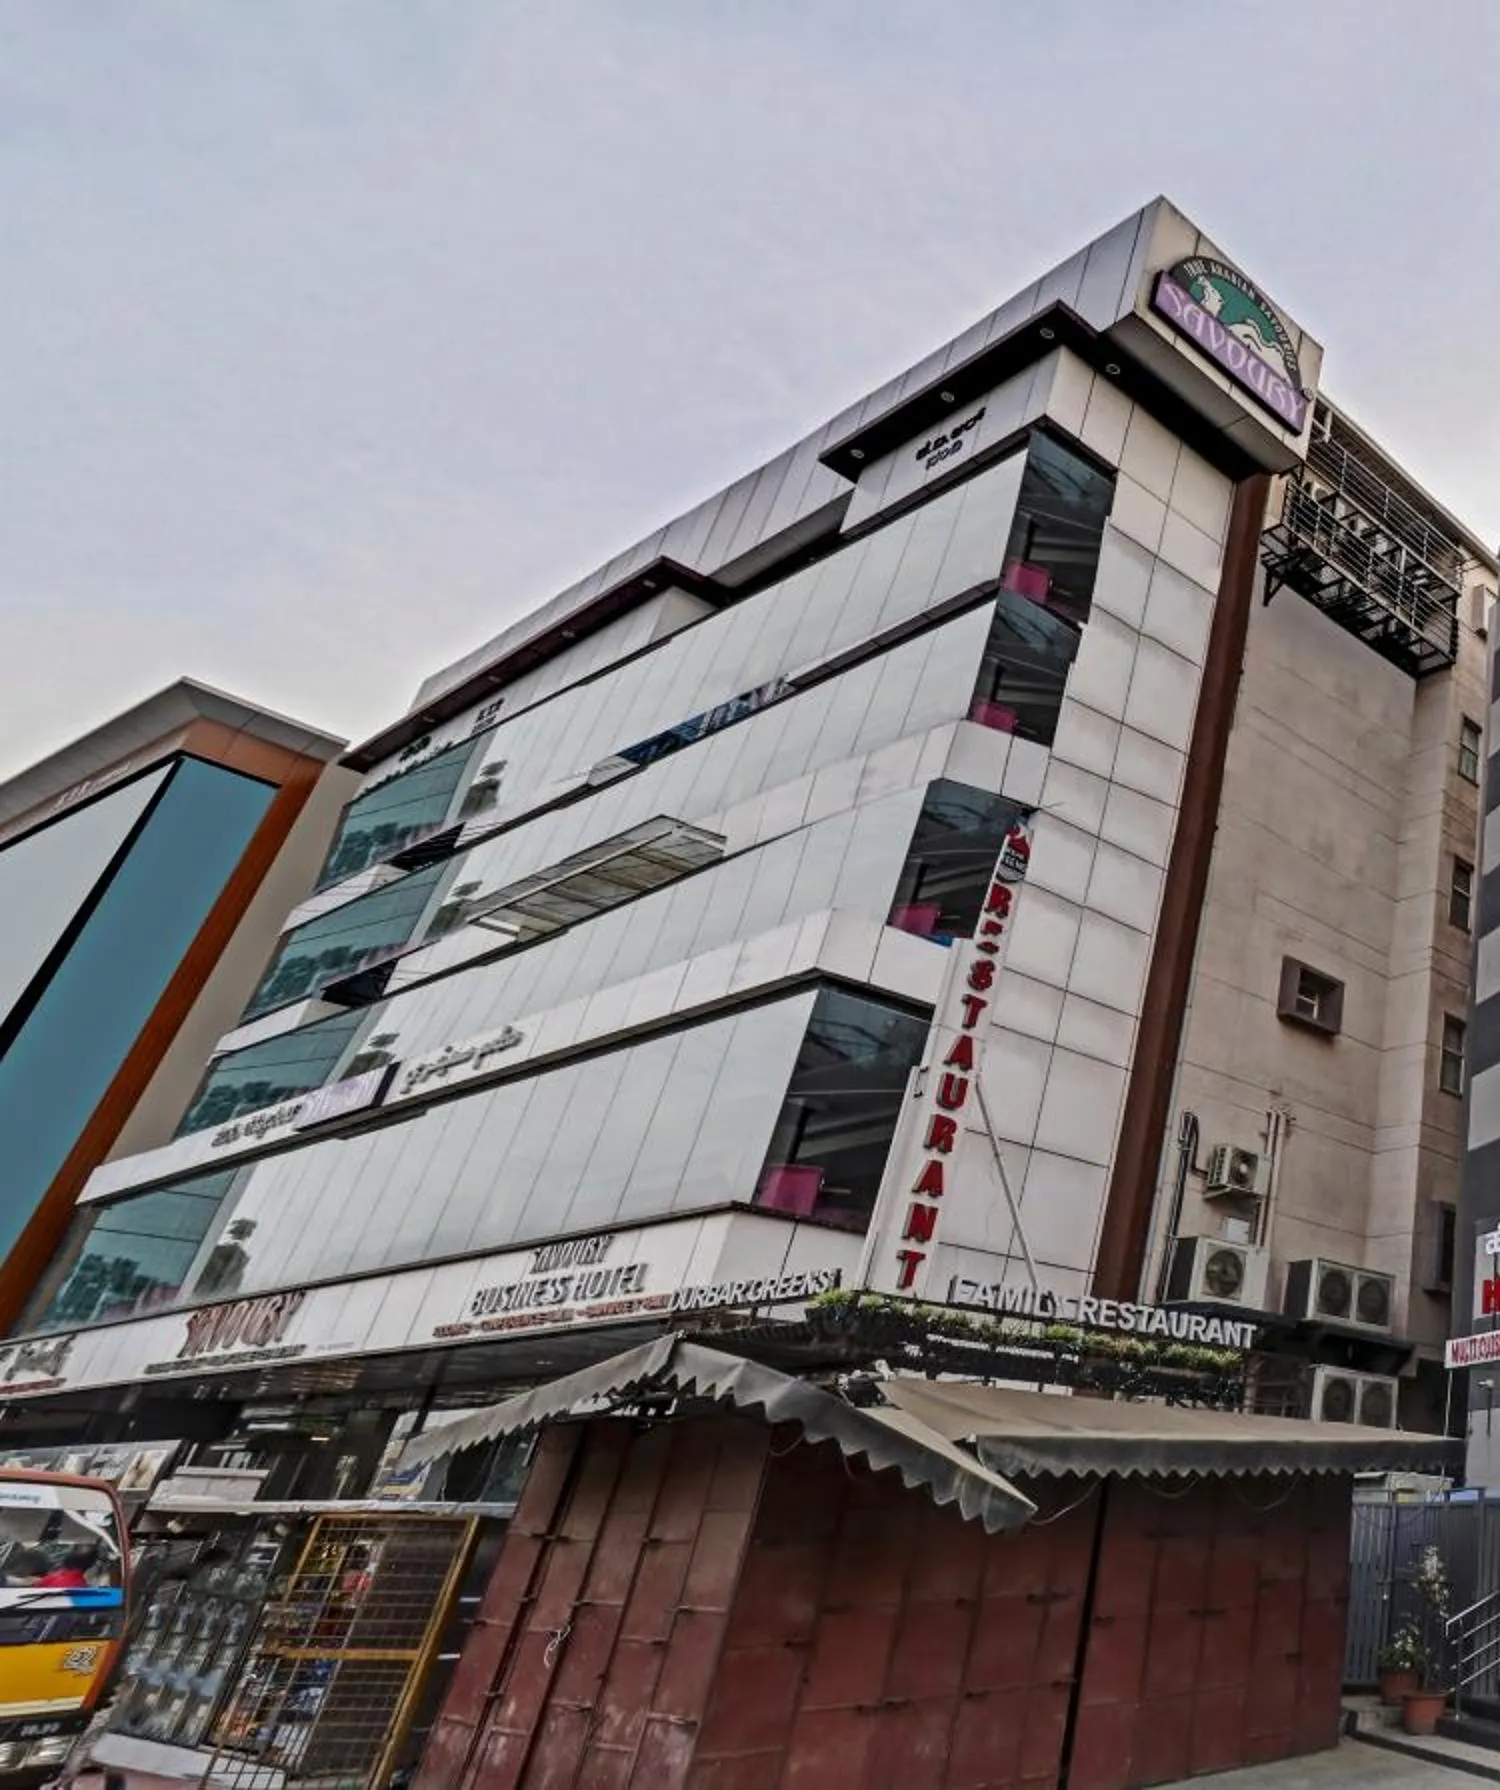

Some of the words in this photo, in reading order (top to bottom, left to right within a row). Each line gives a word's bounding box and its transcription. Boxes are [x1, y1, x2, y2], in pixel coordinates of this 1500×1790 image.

[1163, 282, 1303, 420] SAVOURY
[529, 1234, 616, 1275] SAVOURY
[471, 1276, 574, 1317] BUSINESS
[573, 1262, 649, 1302] HOTEL
[1078, 1294, 1258, 1350] RESTAURANT
